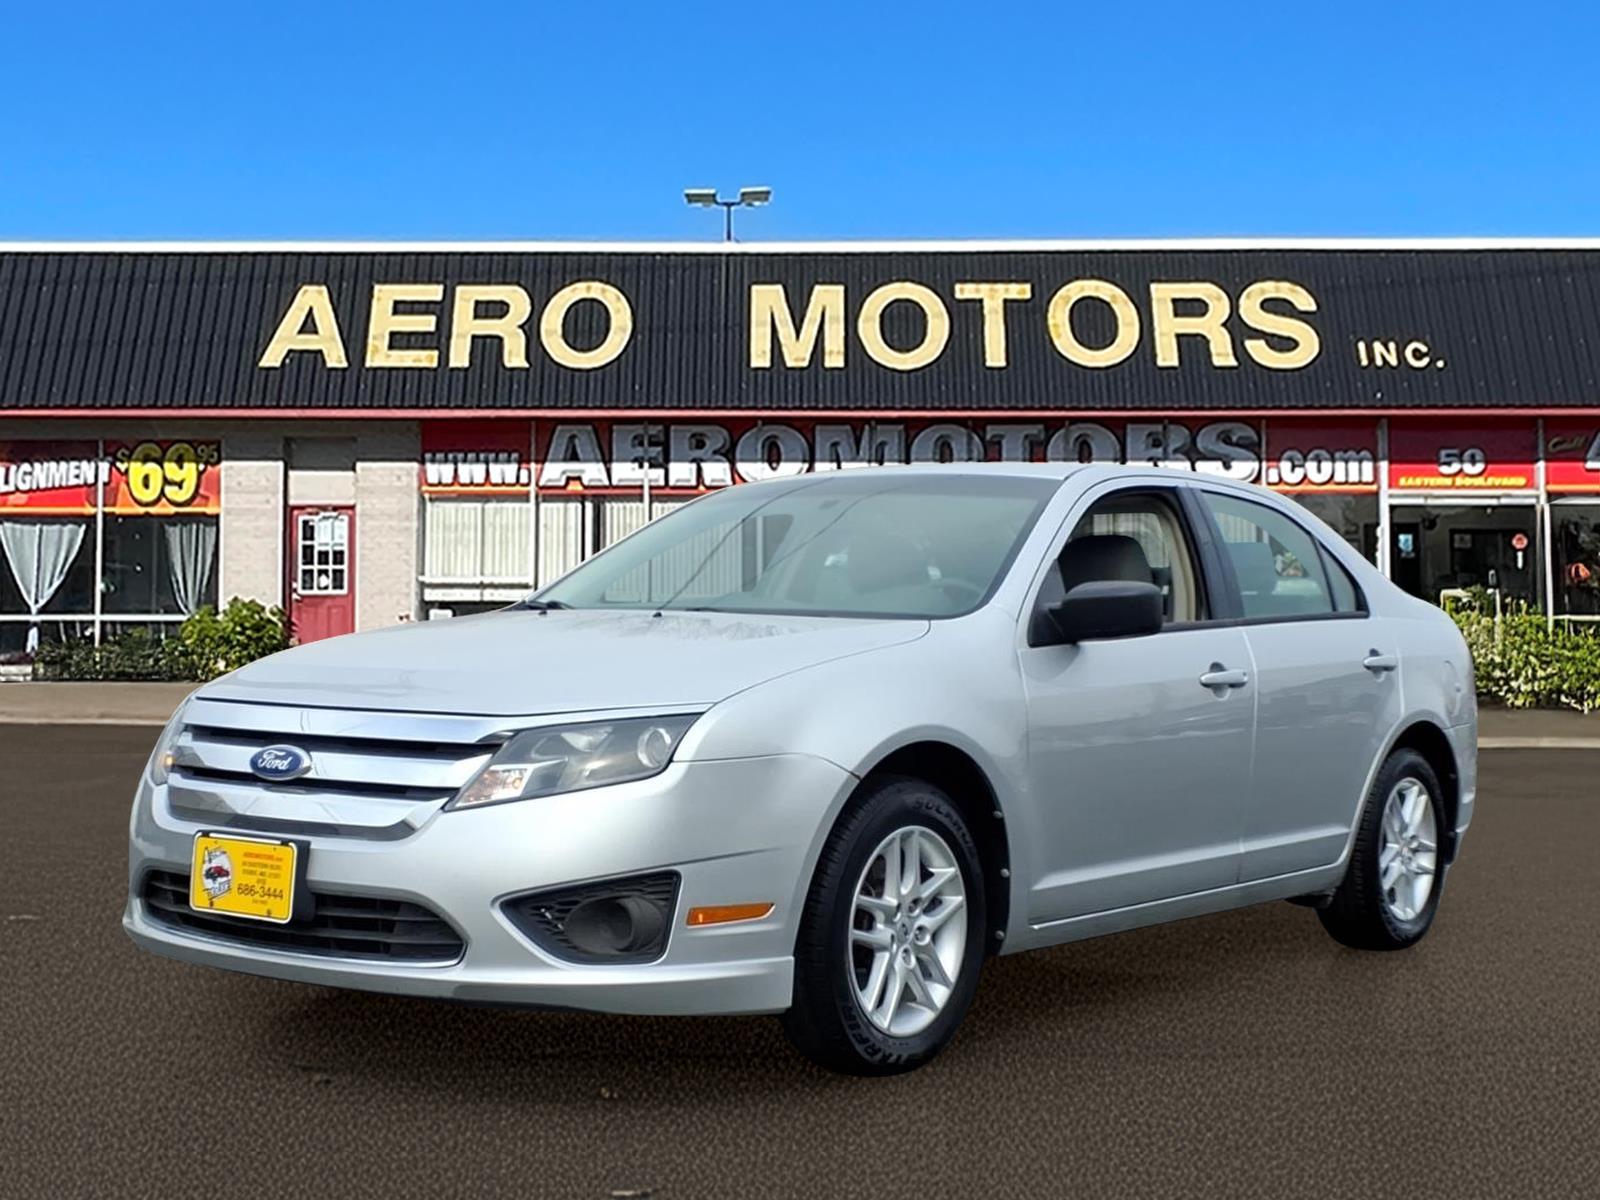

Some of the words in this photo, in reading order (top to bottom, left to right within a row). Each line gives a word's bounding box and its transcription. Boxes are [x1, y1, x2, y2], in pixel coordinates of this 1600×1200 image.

[258, 281, 633, 369] AERO
[750, 279, 1320, 370] MOTORS
[1357, 340, 1445, 368] INC.
[1438, 448, 1486, 476] 50
[257, 750, 293, 770] Ford
[236, 883, 284, 900] 686-3444
